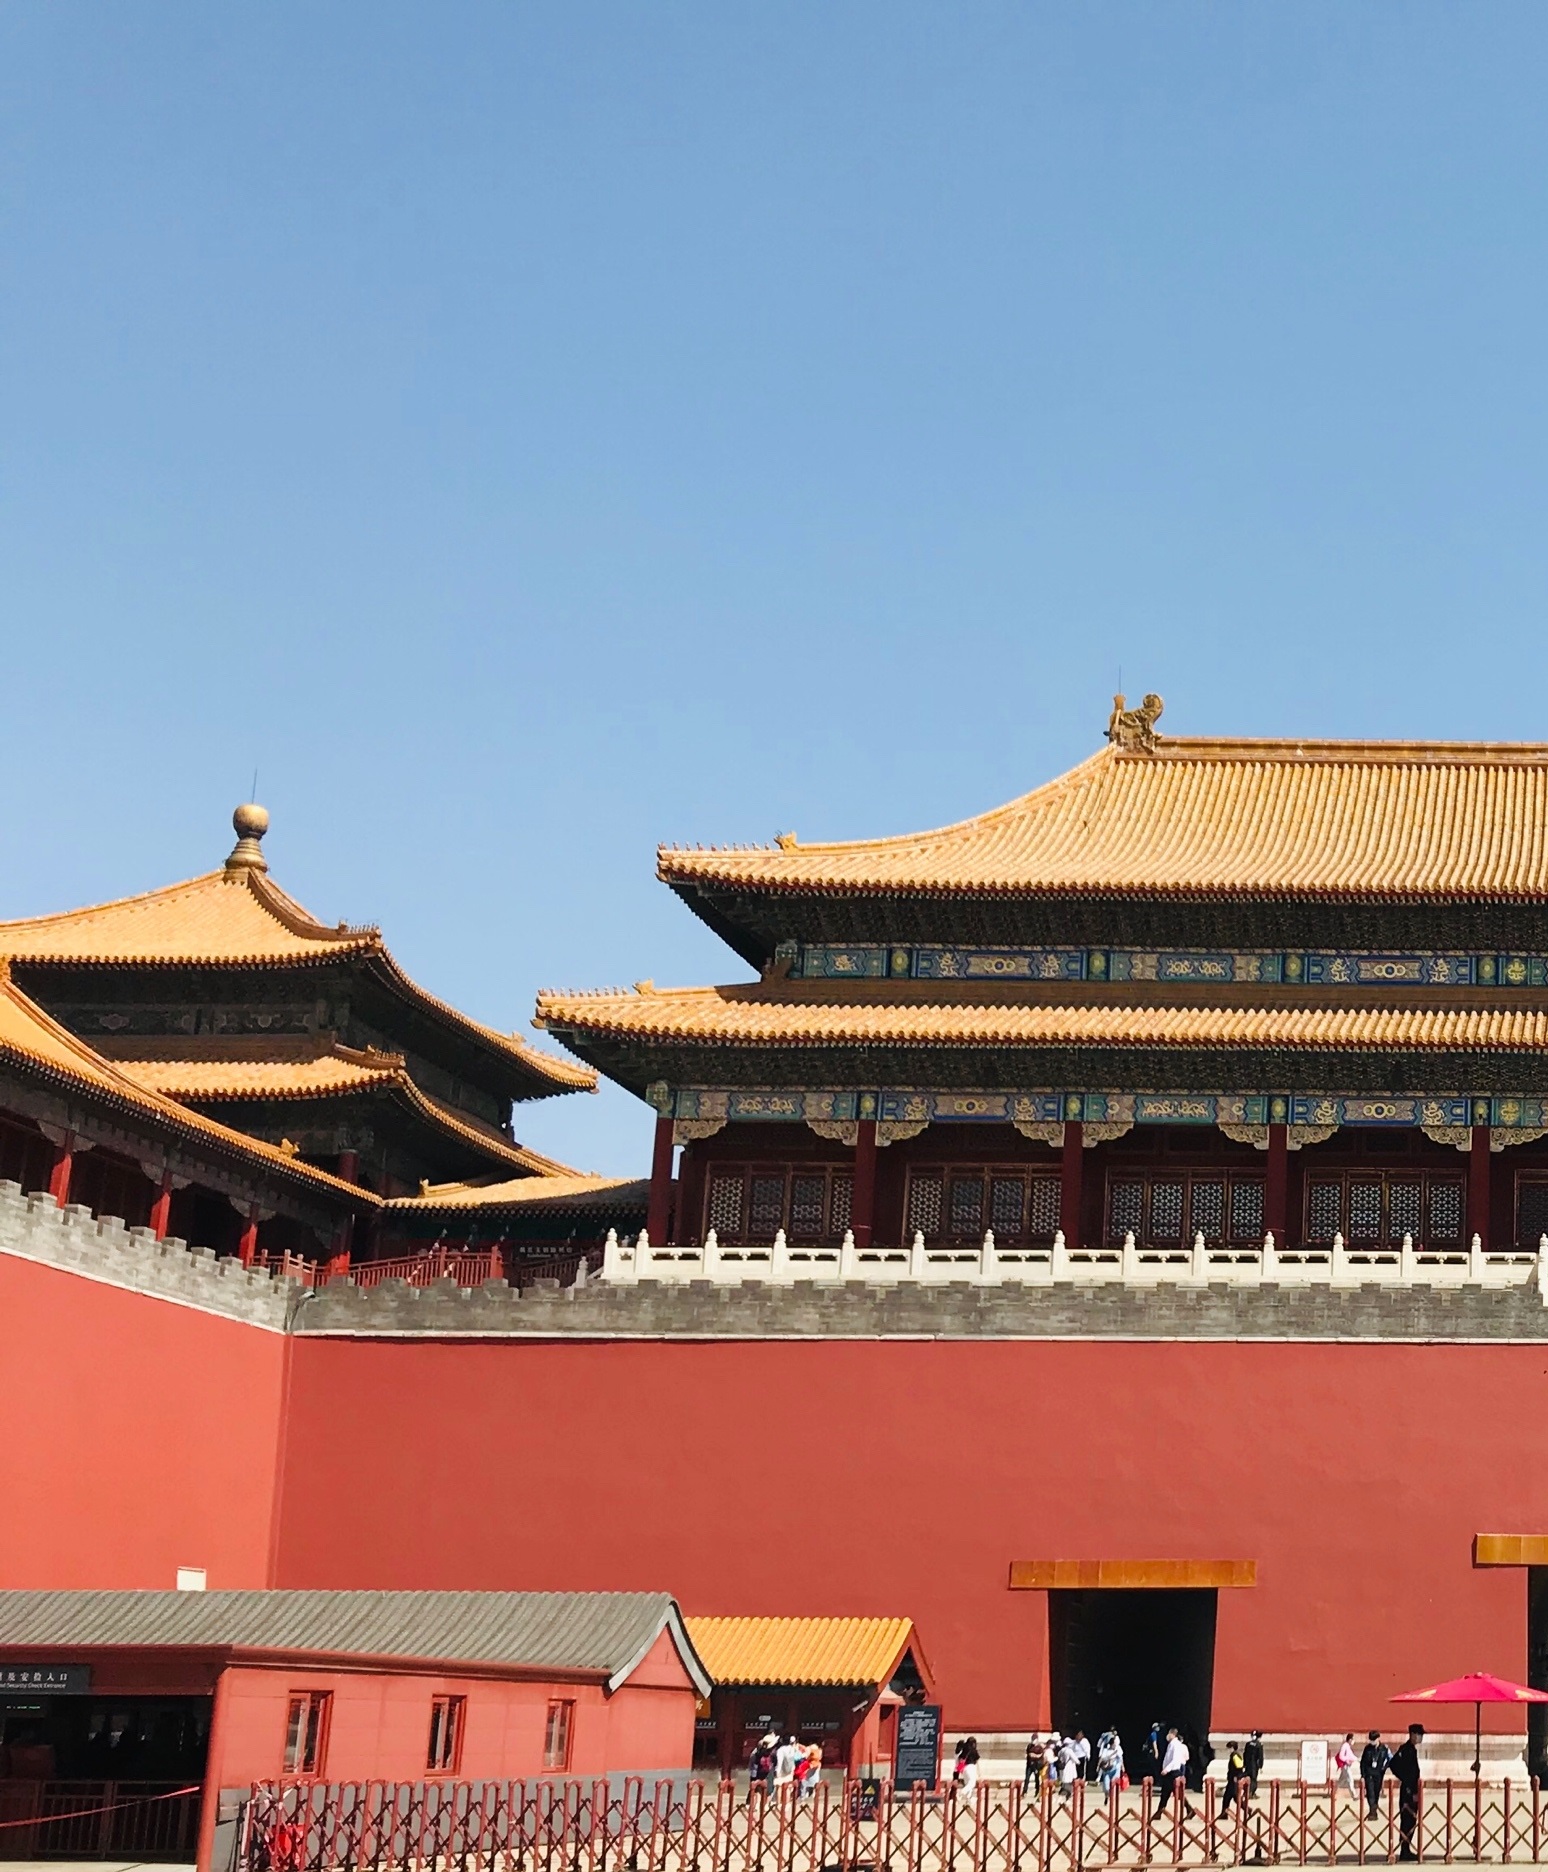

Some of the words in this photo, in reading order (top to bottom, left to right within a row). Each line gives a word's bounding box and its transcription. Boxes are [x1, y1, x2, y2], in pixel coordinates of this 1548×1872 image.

[0, 1672, 67, 1681] 及安检入口
